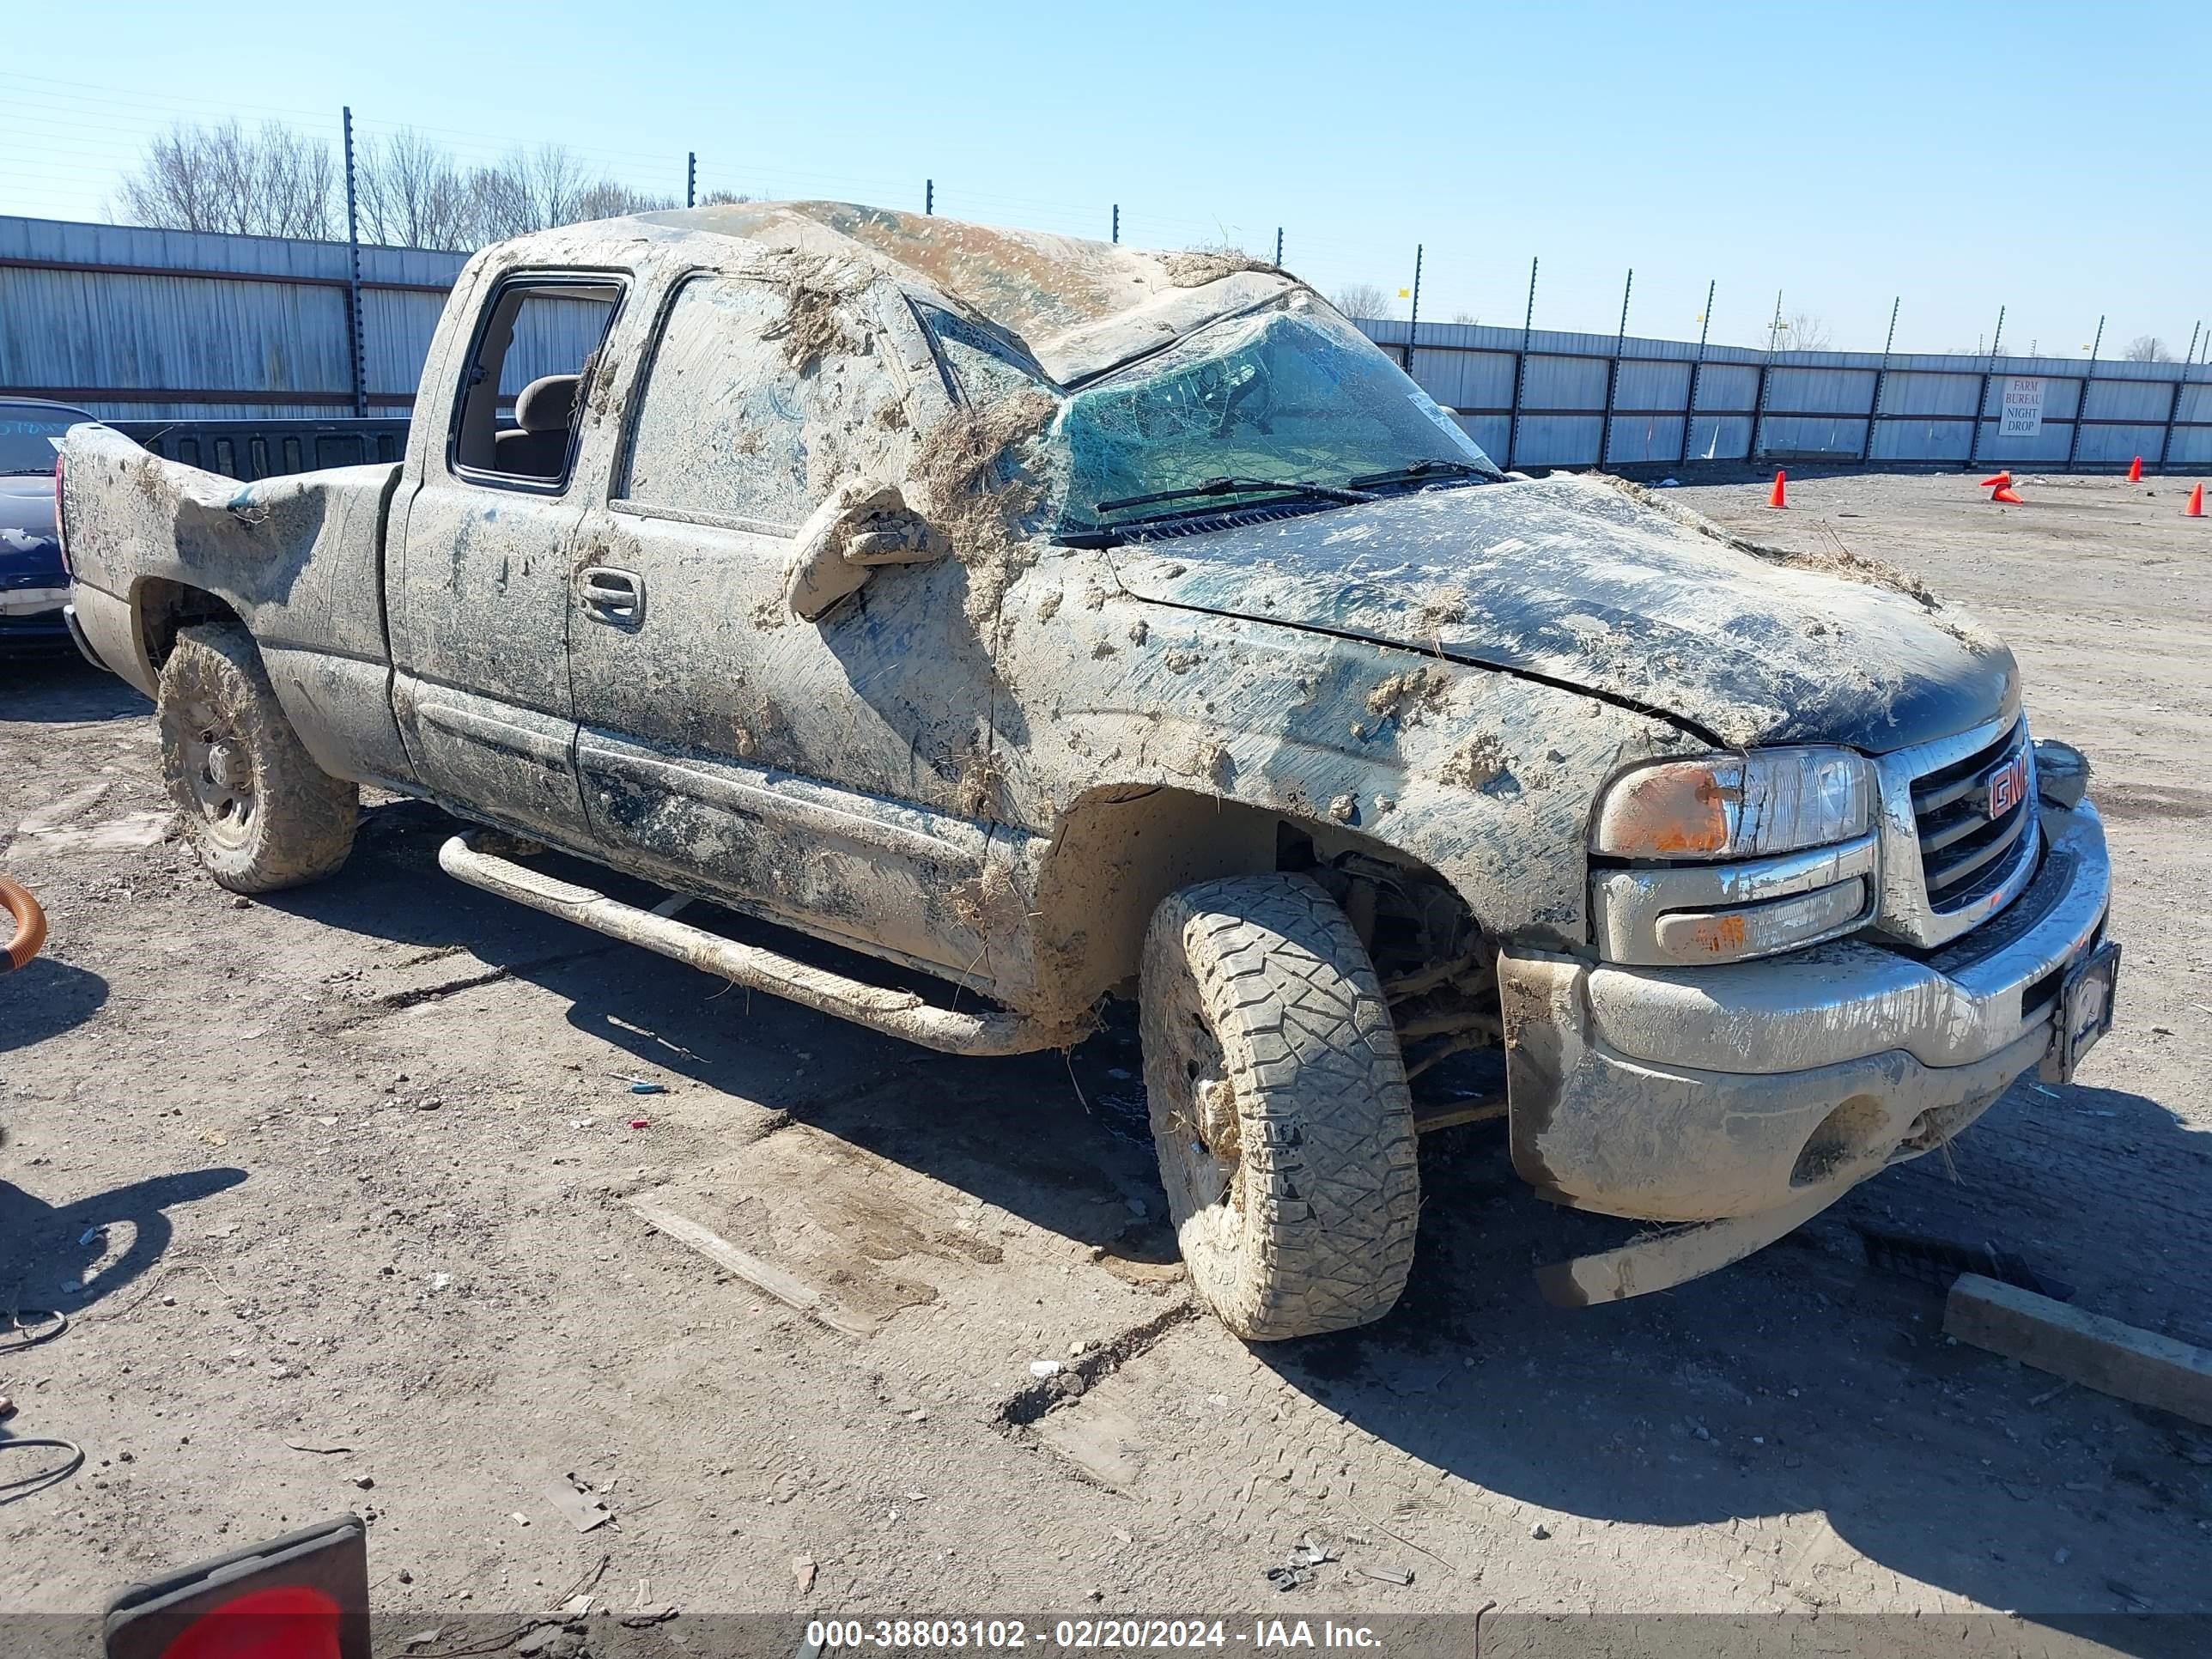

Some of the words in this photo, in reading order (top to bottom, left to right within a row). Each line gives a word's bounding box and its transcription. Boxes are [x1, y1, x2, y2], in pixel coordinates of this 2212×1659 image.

[2014, 380, 2038, 392] FARM
[2006, 392, 2041, 404] BUREAU
[2007, 407, 2038, 418] NIGHT
[2008, 420, 2034, 431] DROP
[1989, 747, 2027, 820] GM
